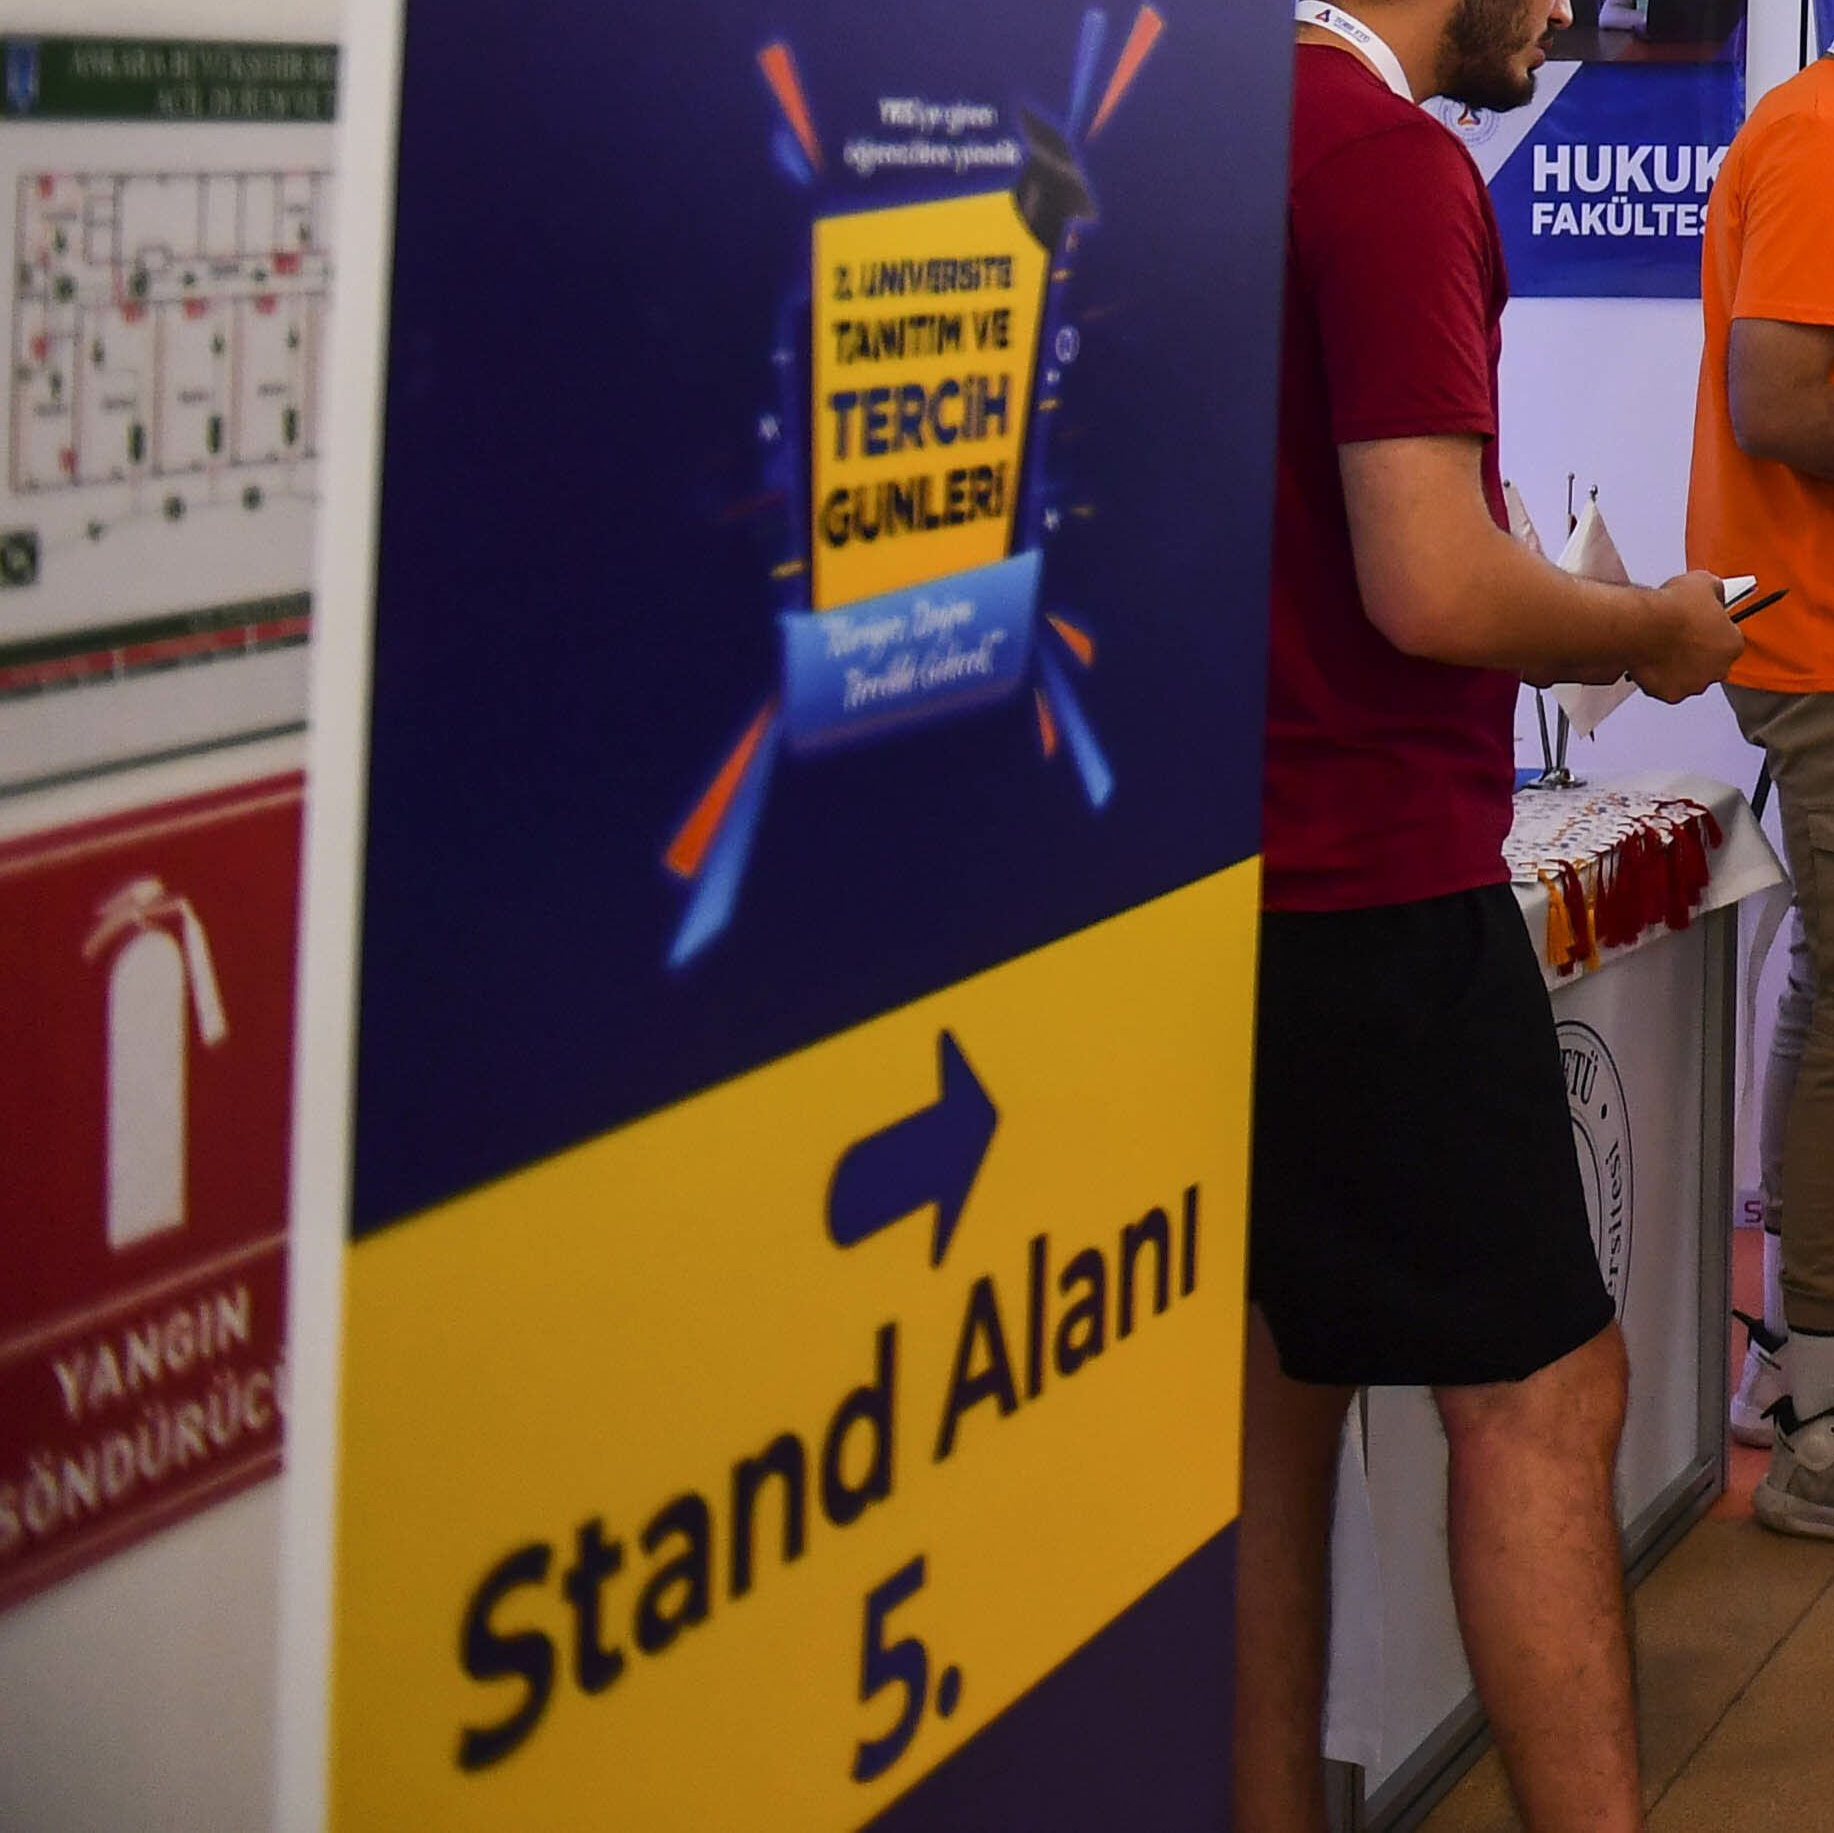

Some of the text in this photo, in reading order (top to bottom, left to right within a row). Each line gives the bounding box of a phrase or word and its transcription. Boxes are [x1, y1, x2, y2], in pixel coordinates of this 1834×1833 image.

[1533, 145, 1730, 193] HUKUK
[972, 307, 1012, 350] VE
[53, 1284, 251, 1419] YANGIN
[0, 1369, 273, 1549] SÖNDÜRÜC
[453, 1182, 1201, 1774] Stand Alanı
[851, 1552, 963, 1785] 5.
